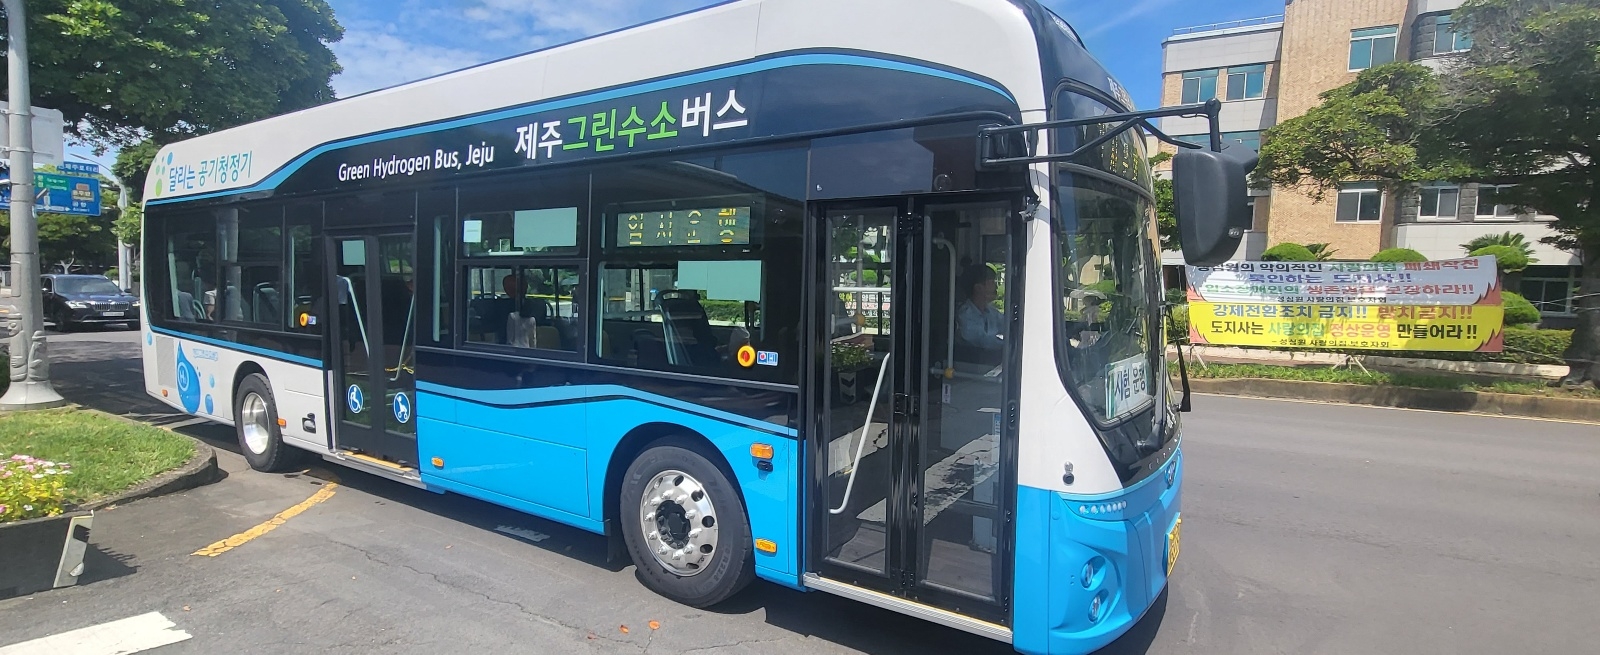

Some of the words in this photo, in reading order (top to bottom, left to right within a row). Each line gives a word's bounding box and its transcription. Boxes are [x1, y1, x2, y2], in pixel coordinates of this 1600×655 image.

[514, 89, 748, 160] 제주그린수소버스
[169, 164, 196, 193] 달리는
[198, 150, 253, 187] 공기청정기
[338, 163, 370, 182] Green
[373, 153, 431, 180] Hydrogen
[434, 149, 462, 171] Bus,
[466, 141, 495, 167] Jeju
[1260, 263, 1322, 273] 악의직인
[1329, 262, 1397, 272] 사랑의집
[1386, 284, 1474, 295] 보장하라!!
[1212, 304, 1312, 319] 강제전환조치
[1319, 305, 1367, 319] 금지!!
[1211, 320, 1264, 335] 도지사는
[1268, 321, 1325, 337] 사랑의집
[1331, 323, 1391, 338] 정상운영
[1115, 368, 1131, 401] 시험
